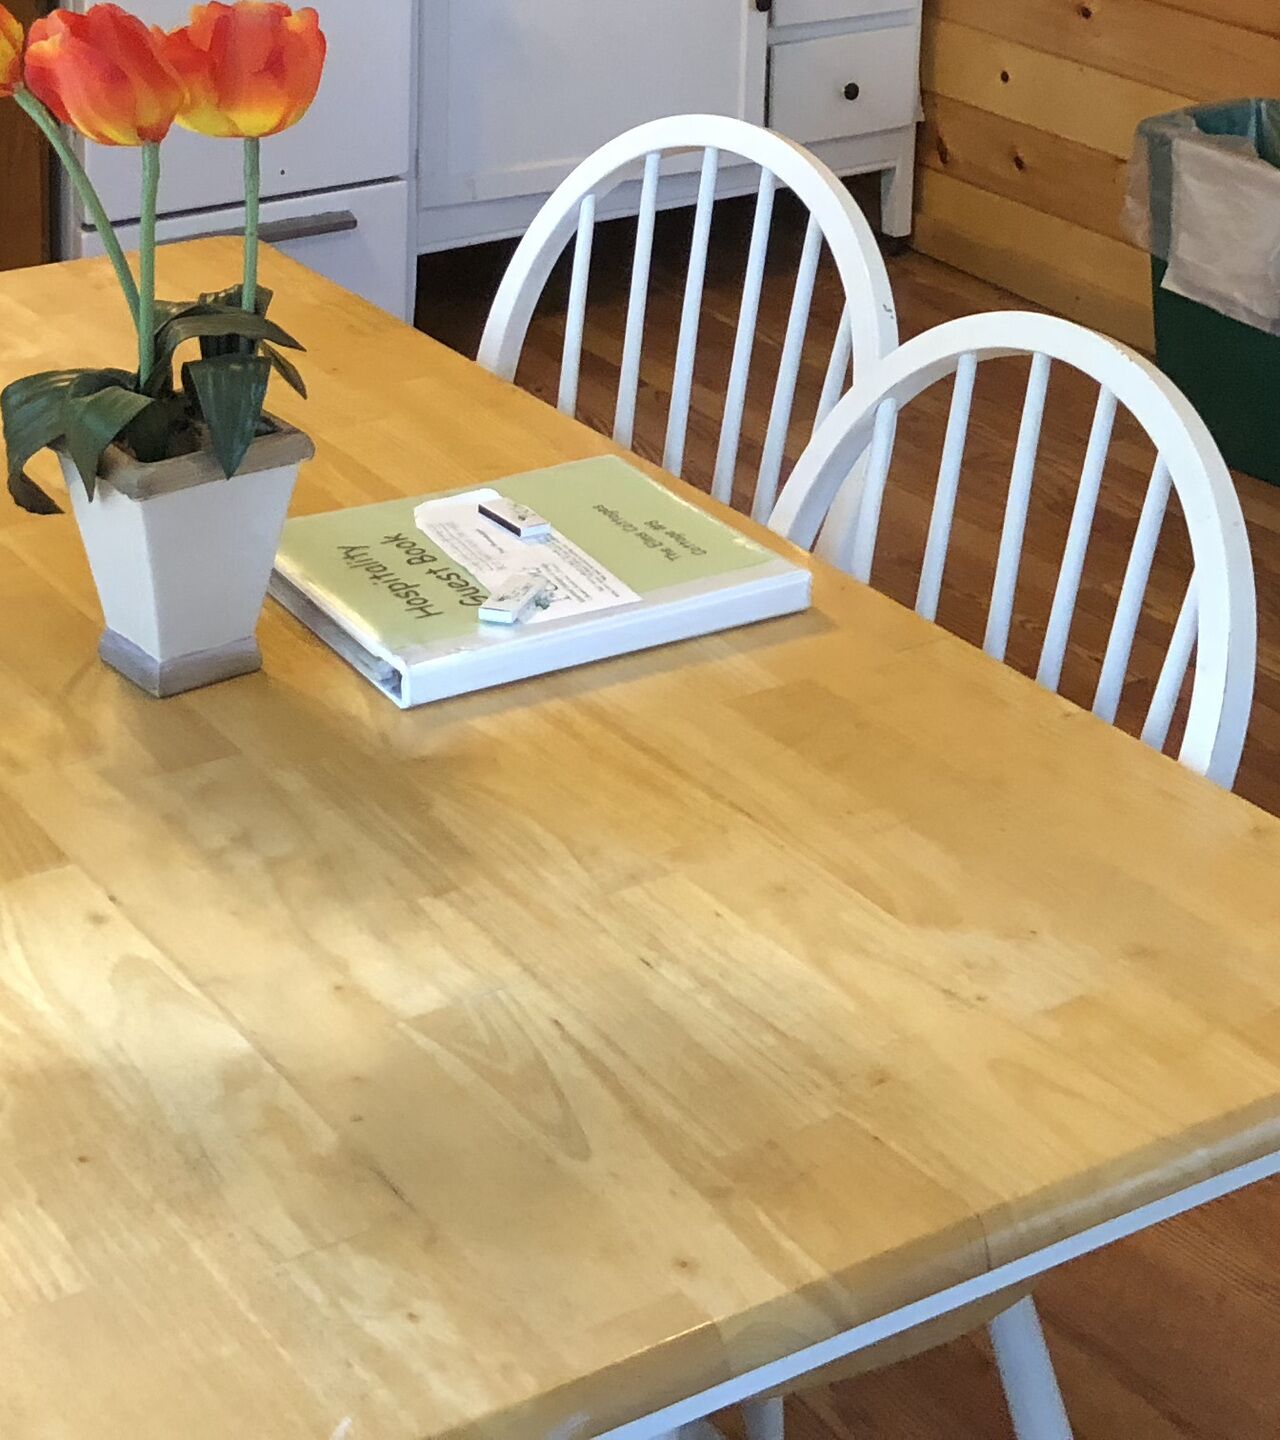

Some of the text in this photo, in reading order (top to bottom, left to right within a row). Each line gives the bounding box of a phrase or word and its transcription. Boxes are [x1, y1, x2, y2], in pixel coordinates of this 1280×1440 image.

[380, 533, 437, 566] Book
[337, 545, 444, 619] Hospitality
[425, 567, 489, 606] Guest
